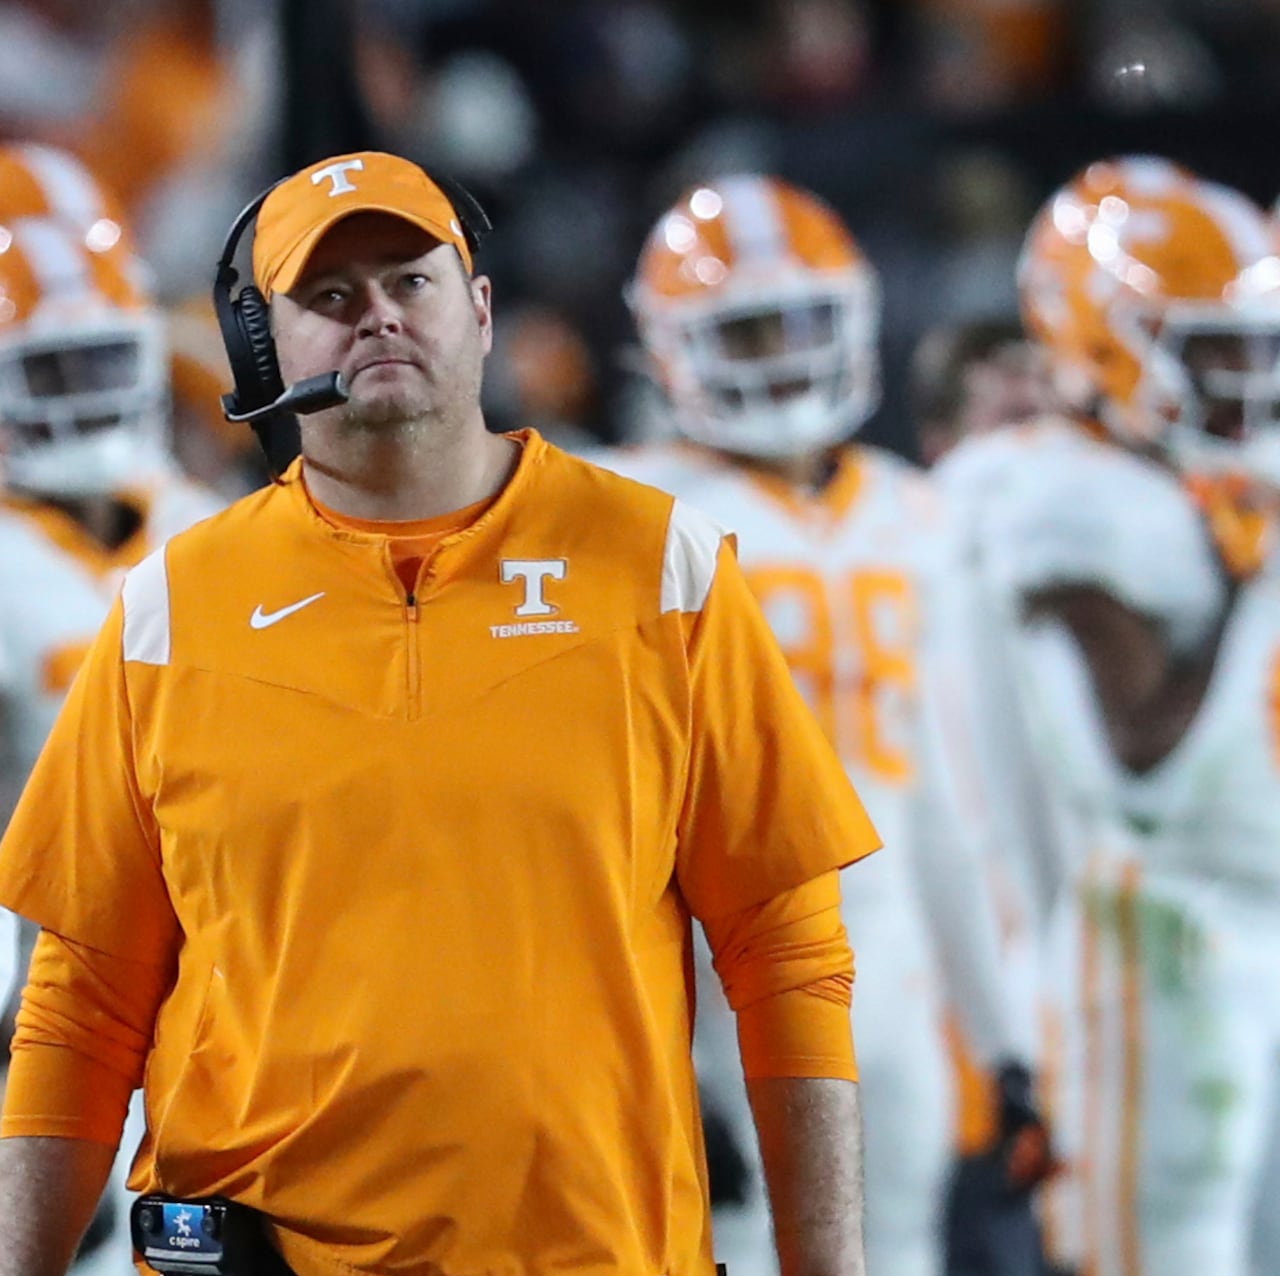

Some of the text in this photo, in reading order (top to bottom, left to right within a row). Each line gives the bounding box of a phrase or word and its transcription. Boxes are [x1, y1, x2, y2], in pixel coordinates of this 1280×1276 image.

[311, 159, 364, 197] T
[500, 558, 567, 616] T
[489, 620, 576, 639] TENNESSEE
